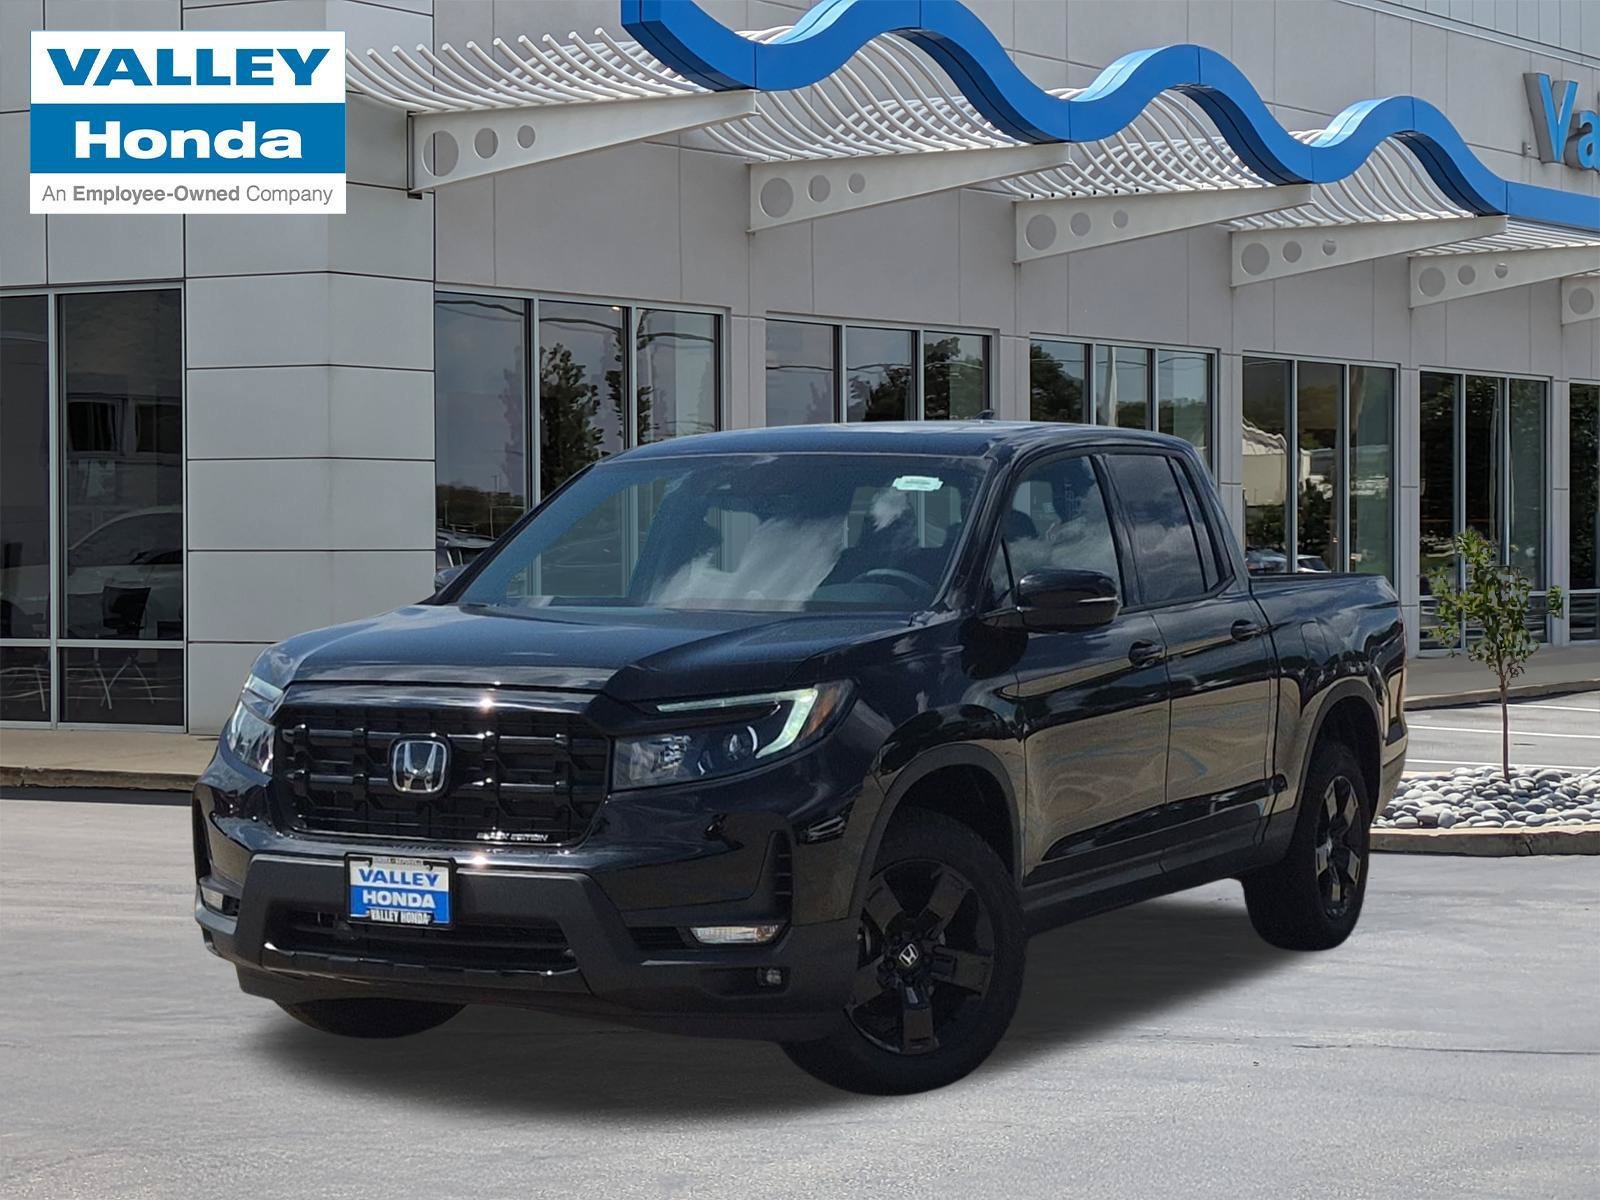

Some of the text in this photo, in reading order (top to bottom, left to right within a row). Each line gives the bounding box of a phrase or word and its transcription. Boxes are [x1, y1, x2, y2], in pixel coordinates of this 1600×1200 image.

[358, 867, 440, 887] VALLEY
[362, 889, 436, 909] HONDA
[370, 909, 430, 925] VALLEY HONDA
